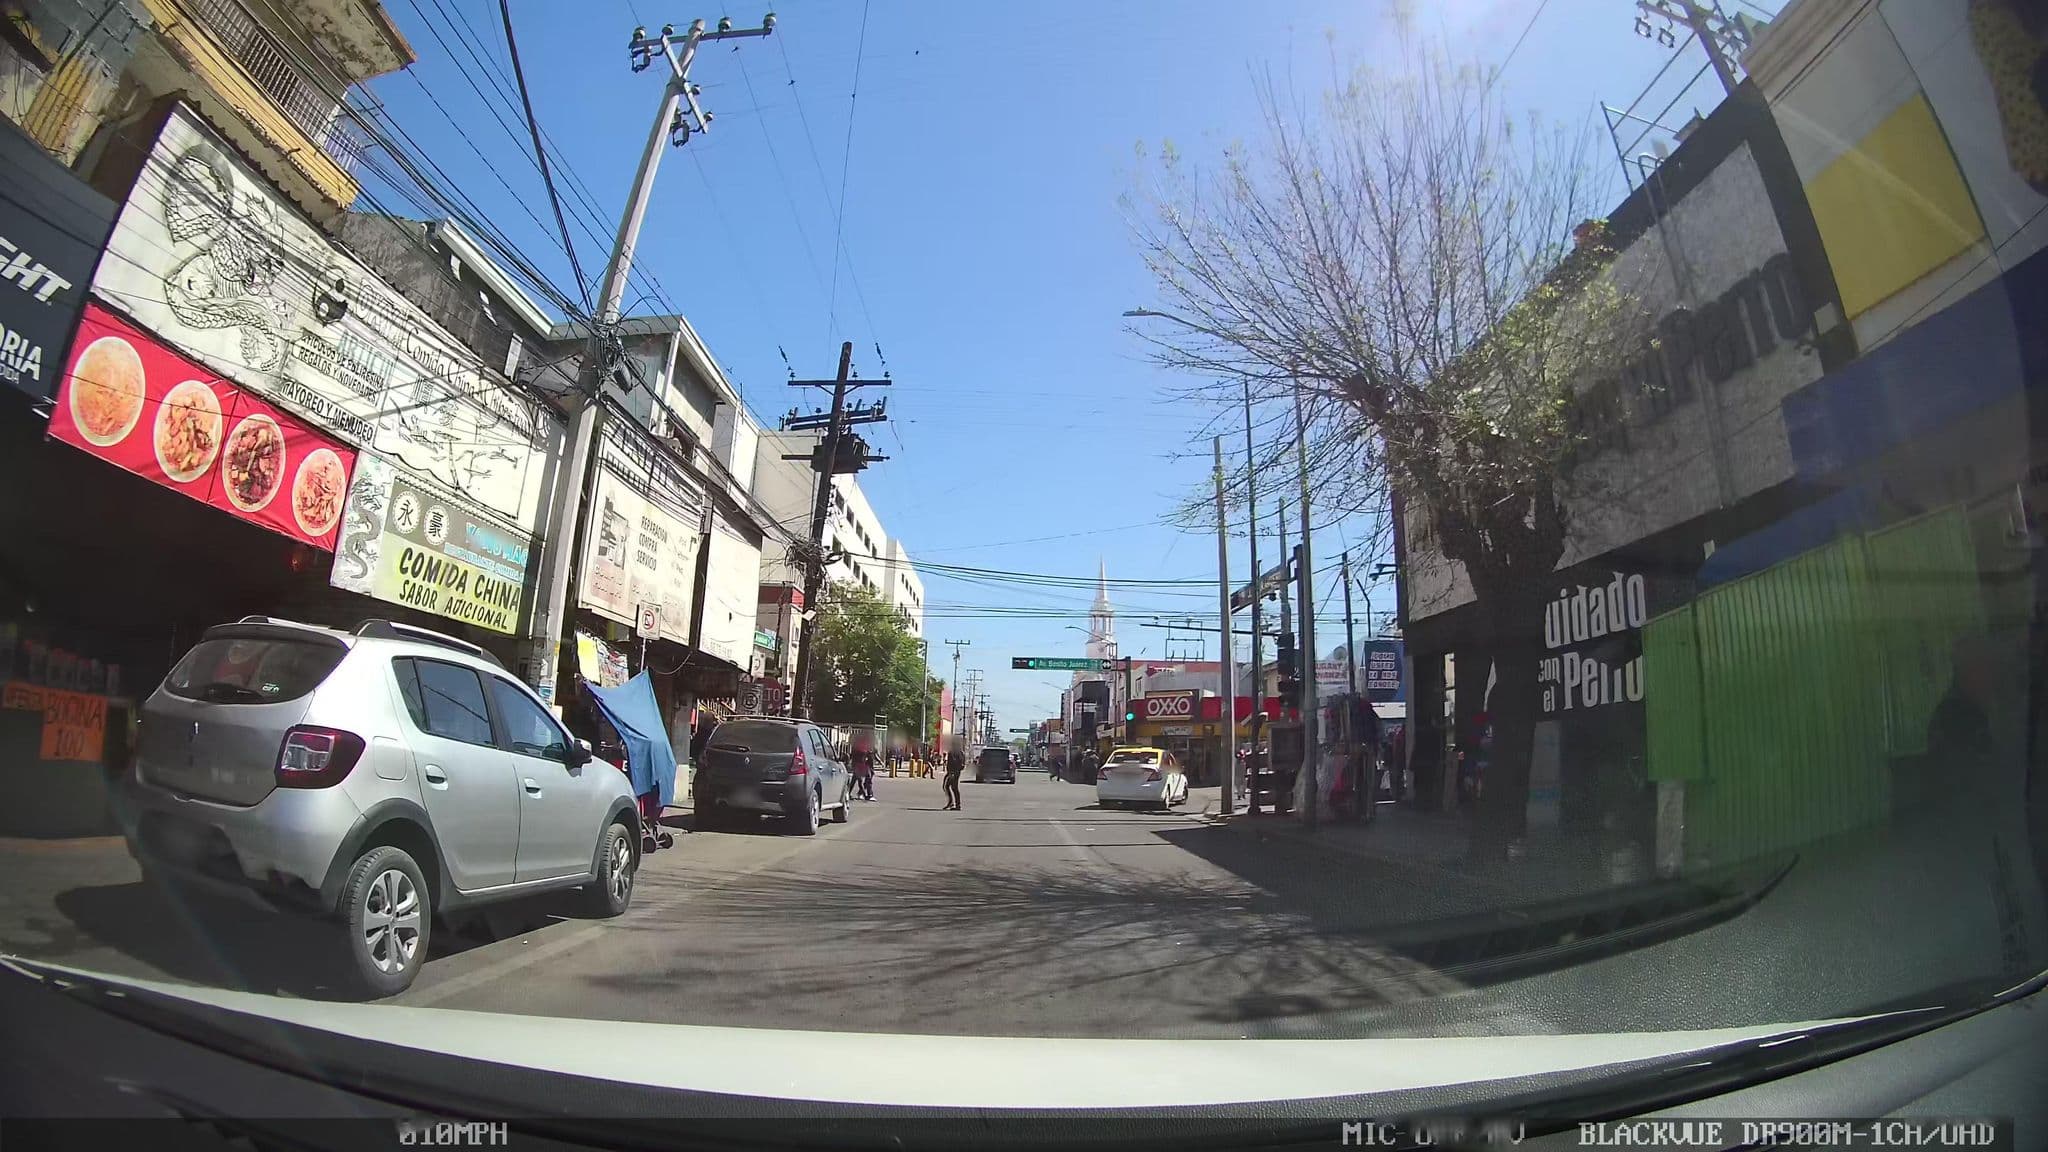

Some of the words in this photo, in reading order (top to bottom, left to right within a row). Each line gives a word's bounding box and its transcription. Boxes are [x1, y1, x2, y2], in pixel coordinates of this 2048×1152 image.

[299, 346, 332, 376] REGALOS
[281, 381, 324, 414] MAYOREO
[326, 402, 333, 417] Y
[334, 408, 373, 442] MENUDEO
[399, 580, 438, 610] SABOR
[444, 596, 508, 630] ADICIONAL
[400, 547, 469, 595] COMIDA
[474, 574, 521, 613] CHINA
[1545, 571, 1647, 649] uidado
[1147, 697, 1190, 716] OXXO
